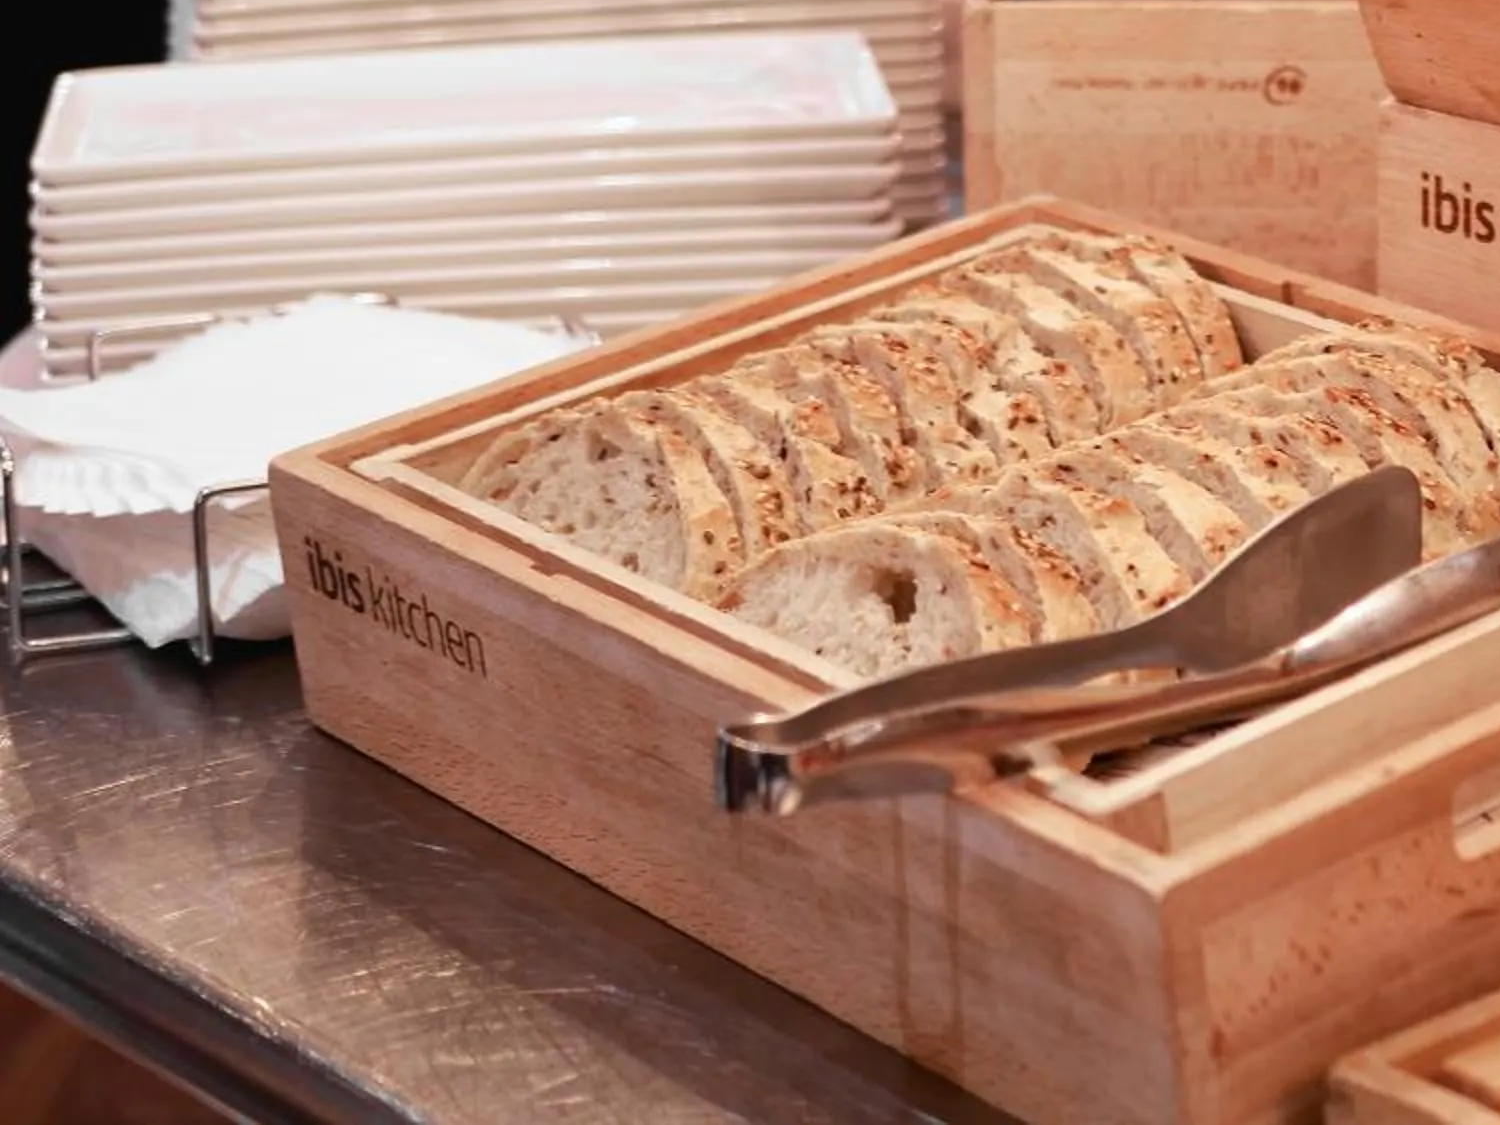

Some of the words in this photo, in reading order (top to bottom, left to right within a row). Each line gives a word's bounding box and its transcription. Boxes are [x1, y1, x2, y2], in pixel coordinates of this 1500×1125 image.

[1419, 171, 1496, 244] ibis
[303, 535, 366, 614] ibis
[366, 565, 487, 677] kitchen
